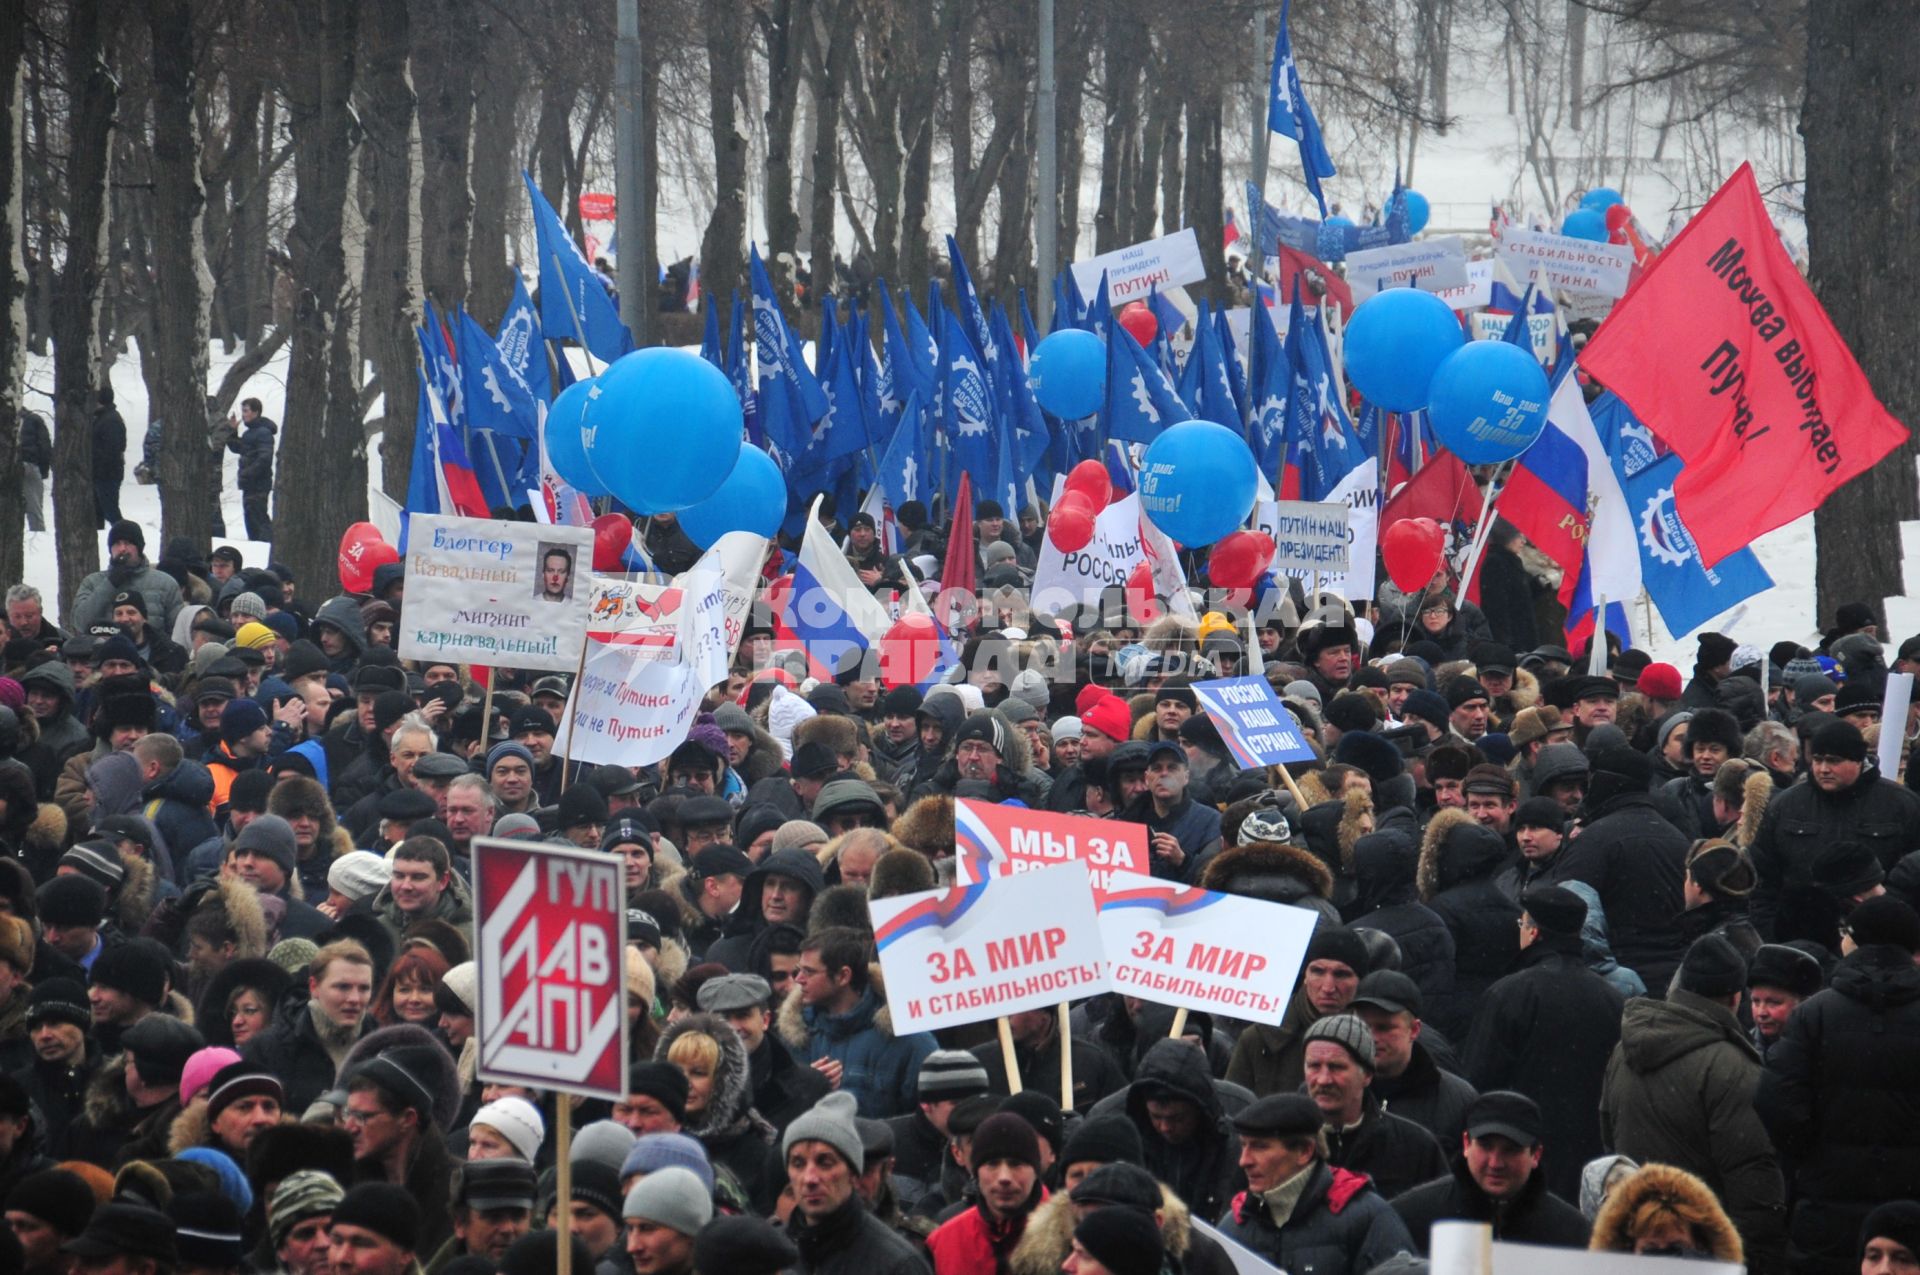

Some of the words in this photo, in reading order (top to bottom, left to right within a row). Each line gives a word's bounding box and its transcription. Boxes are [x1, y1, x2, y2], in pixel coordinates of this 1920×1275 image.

[1110, 256, 1161, 278] ПРЕЗИДЕНТ
[1122, 248, 1144, 261] НАШ
[1510, 243, 1622, 268] СТАБИЛЬНОСТЬ
[1113, 268, 1170, 297] ПУТИН!
[1392, 265, 1436, 283] ПУТИН!
[1529, 269, 1598, 289] ПТИНА!
[1706, 237, 1786, 343] Москва
[1498, 406, 1526, 430] За
[1631, 438, 1654, 463] СОЮЗ
[1143, 472, 1158, 494] За
[1280, 515, 1317, 537] ПУТИН
[1319, 519, 1346, 539] НАШ
[347, 541, 365, 562] ЗА
[1280, 541, 1346, 562] ПРЕЗИДЕНТ!
[415, 554, 518, 584] Навальный
[415, 629, 558, 656] карнавальный!
[613, 681, 676, 708] Путина.
[1217, 683, 1268, 706] РОССИЯ
[589, 715, 604, 733] не
[607, 718, 671, 742] Путин.
[1238, 708, 1279, 729] НАША
[1247, 731, 1301, 754] СТРАНА!
[1010, 826, 1077, 861] МЫ
[1087, 837, 1134, 870] ЗА
[547, 857, 617, 914] ГУП
[926, 946, 977, 985] ЗА
[985, 927, 1068, 970] МИР
[1131, 931, 1176, 964] ЗА
[1186, 942, 1268, 981] МИР
[907, 1000, 924, 1019] И
[928, 962, 1101, 1015] СТАБИЛЬНОСТЬ!
[1115, 965, 1281, 1014] СТАБИЛЬНОСТЬ!
